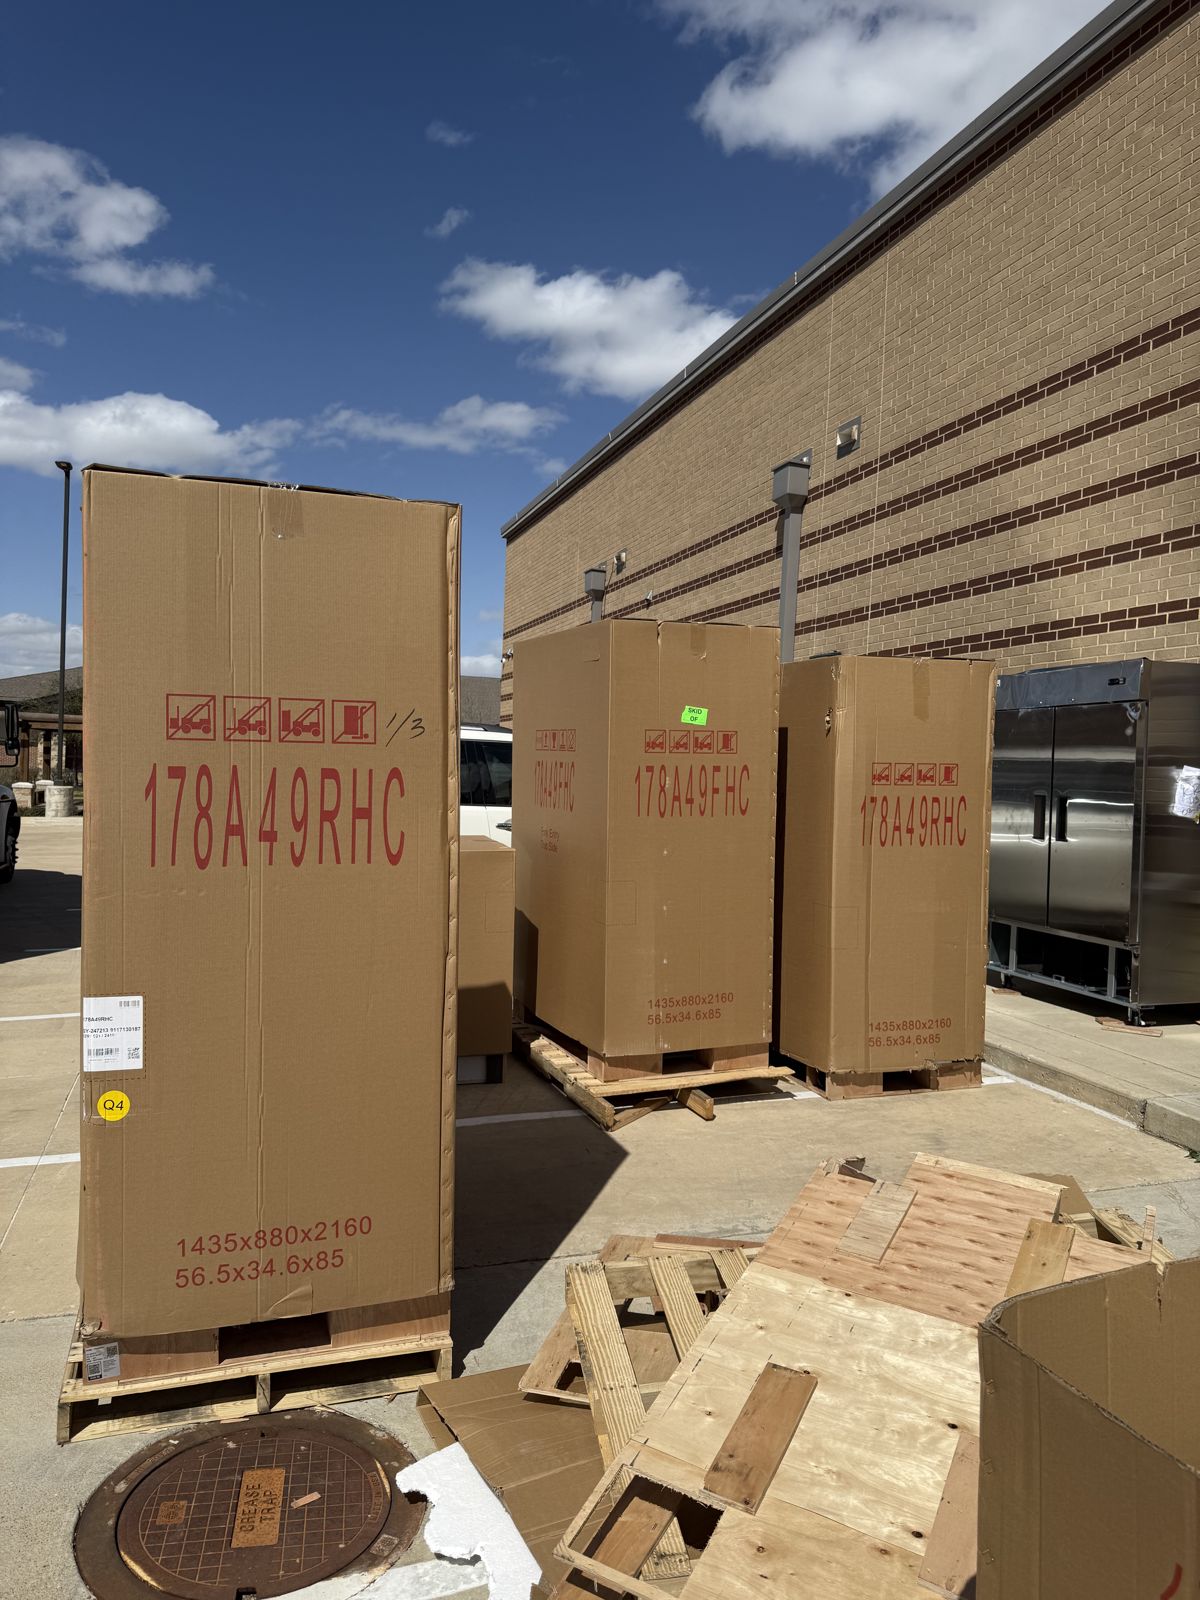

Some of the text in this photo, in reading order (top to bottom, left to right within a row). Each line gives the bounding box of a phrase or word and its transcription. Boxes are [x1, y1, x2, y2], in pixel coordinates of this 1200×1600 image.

[385, 708, 426, 748] 1/3
[687, 707, 703, 715] SKID
[634, 764, 750, 818] 178A49FHC
[144, 762, 406, 871] 178A49RHC
[860, 795, 967, 848] 178A49RHC
[647, 992, 734, 1009] 1435x880x2160
[647, 1008, 722, 1025] 56.5x34.6x85
[868, 1017, 952, 1032] 1435x880x2160
[868, 1033, 941, 1048] 56.5x34.6x85
[103, 1099, 124, 1111] Q4
[176, 1215, 373, 1257] 1435x880x2160
[175, 1248, 344, 1288] 56.5x34.6x85
[240, 1483, 263, 1533] GREASE
[259, 1489, 279, 1524] TRAP
